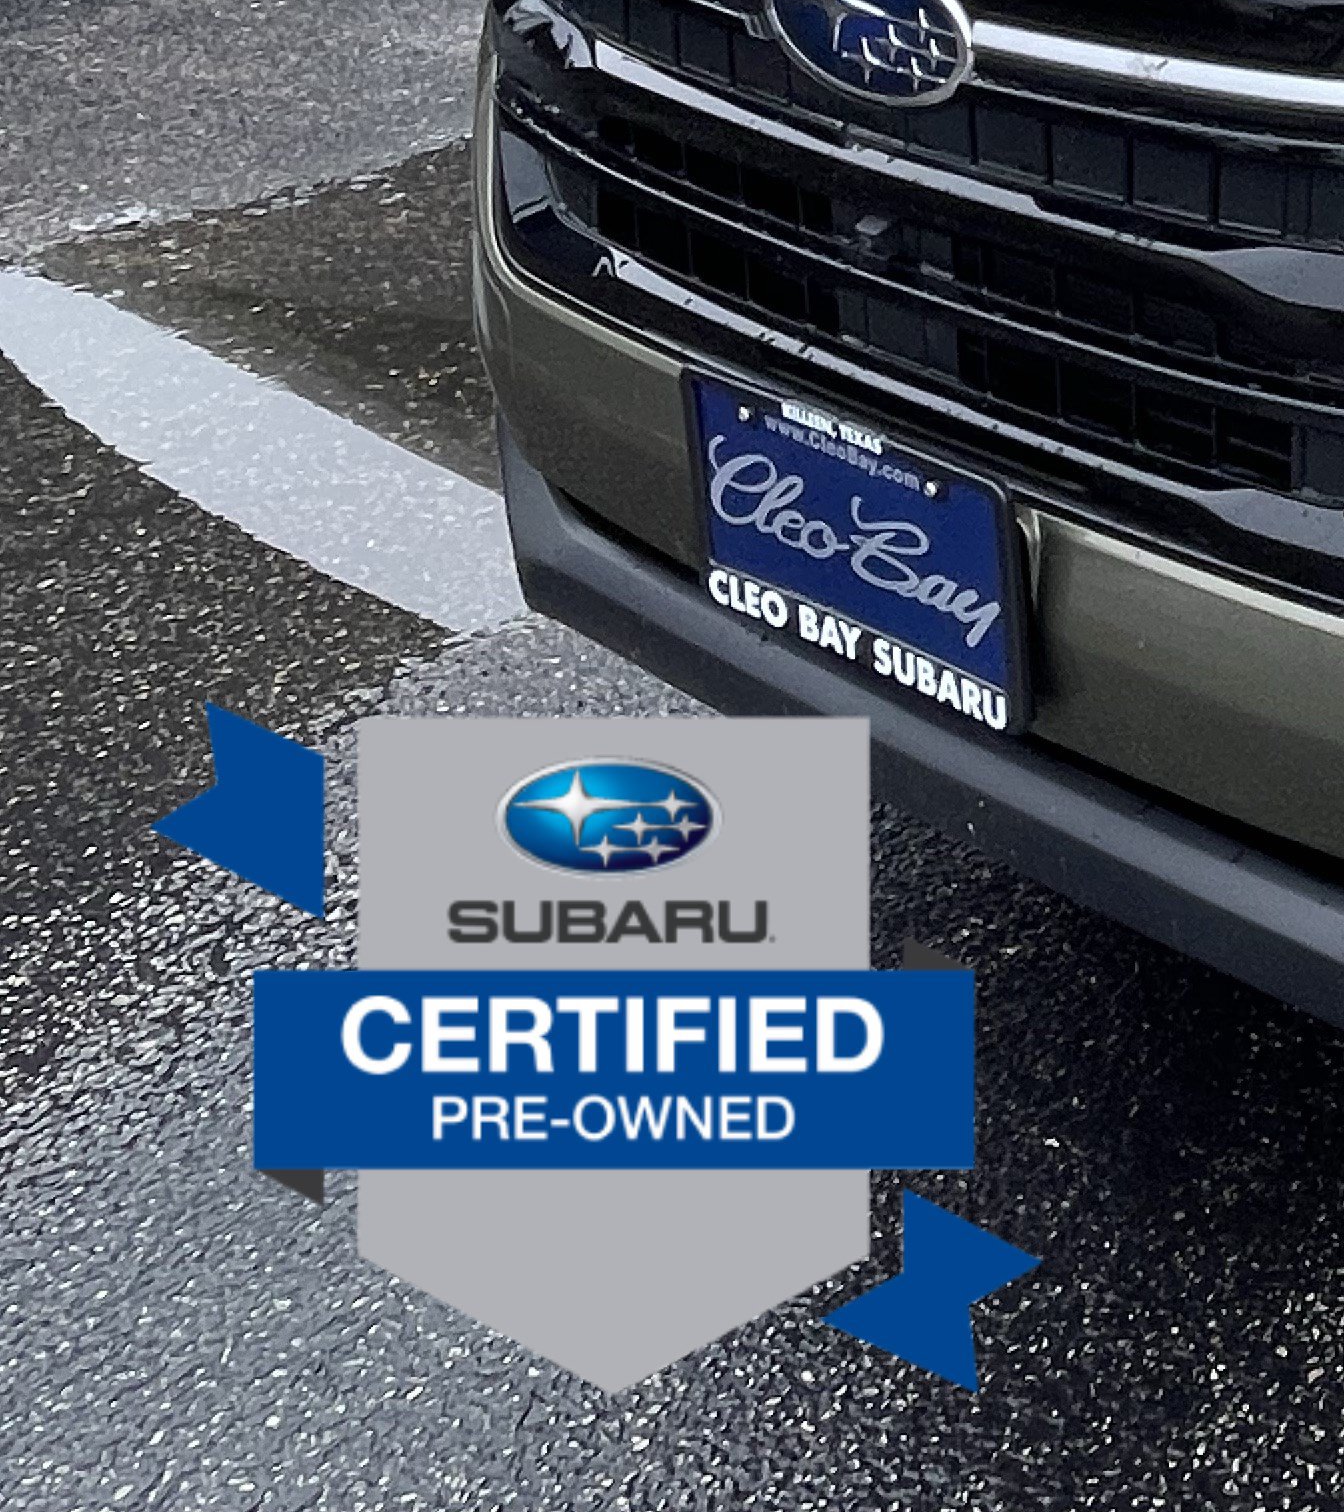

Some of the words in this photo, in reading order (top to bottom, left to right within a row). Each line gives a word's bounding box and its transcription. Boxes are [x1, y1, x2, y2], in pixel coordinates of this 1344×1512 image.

[838, 421, 883, 456] TEXAS
[708, 434, 850, 559] Cleo
[850, 495, 1001, 648] Bay
[708, 569, 789, 628] CLEO
[798, 604, 862, 660] BAY
[872, 638, 1008, 730] SUBARU
